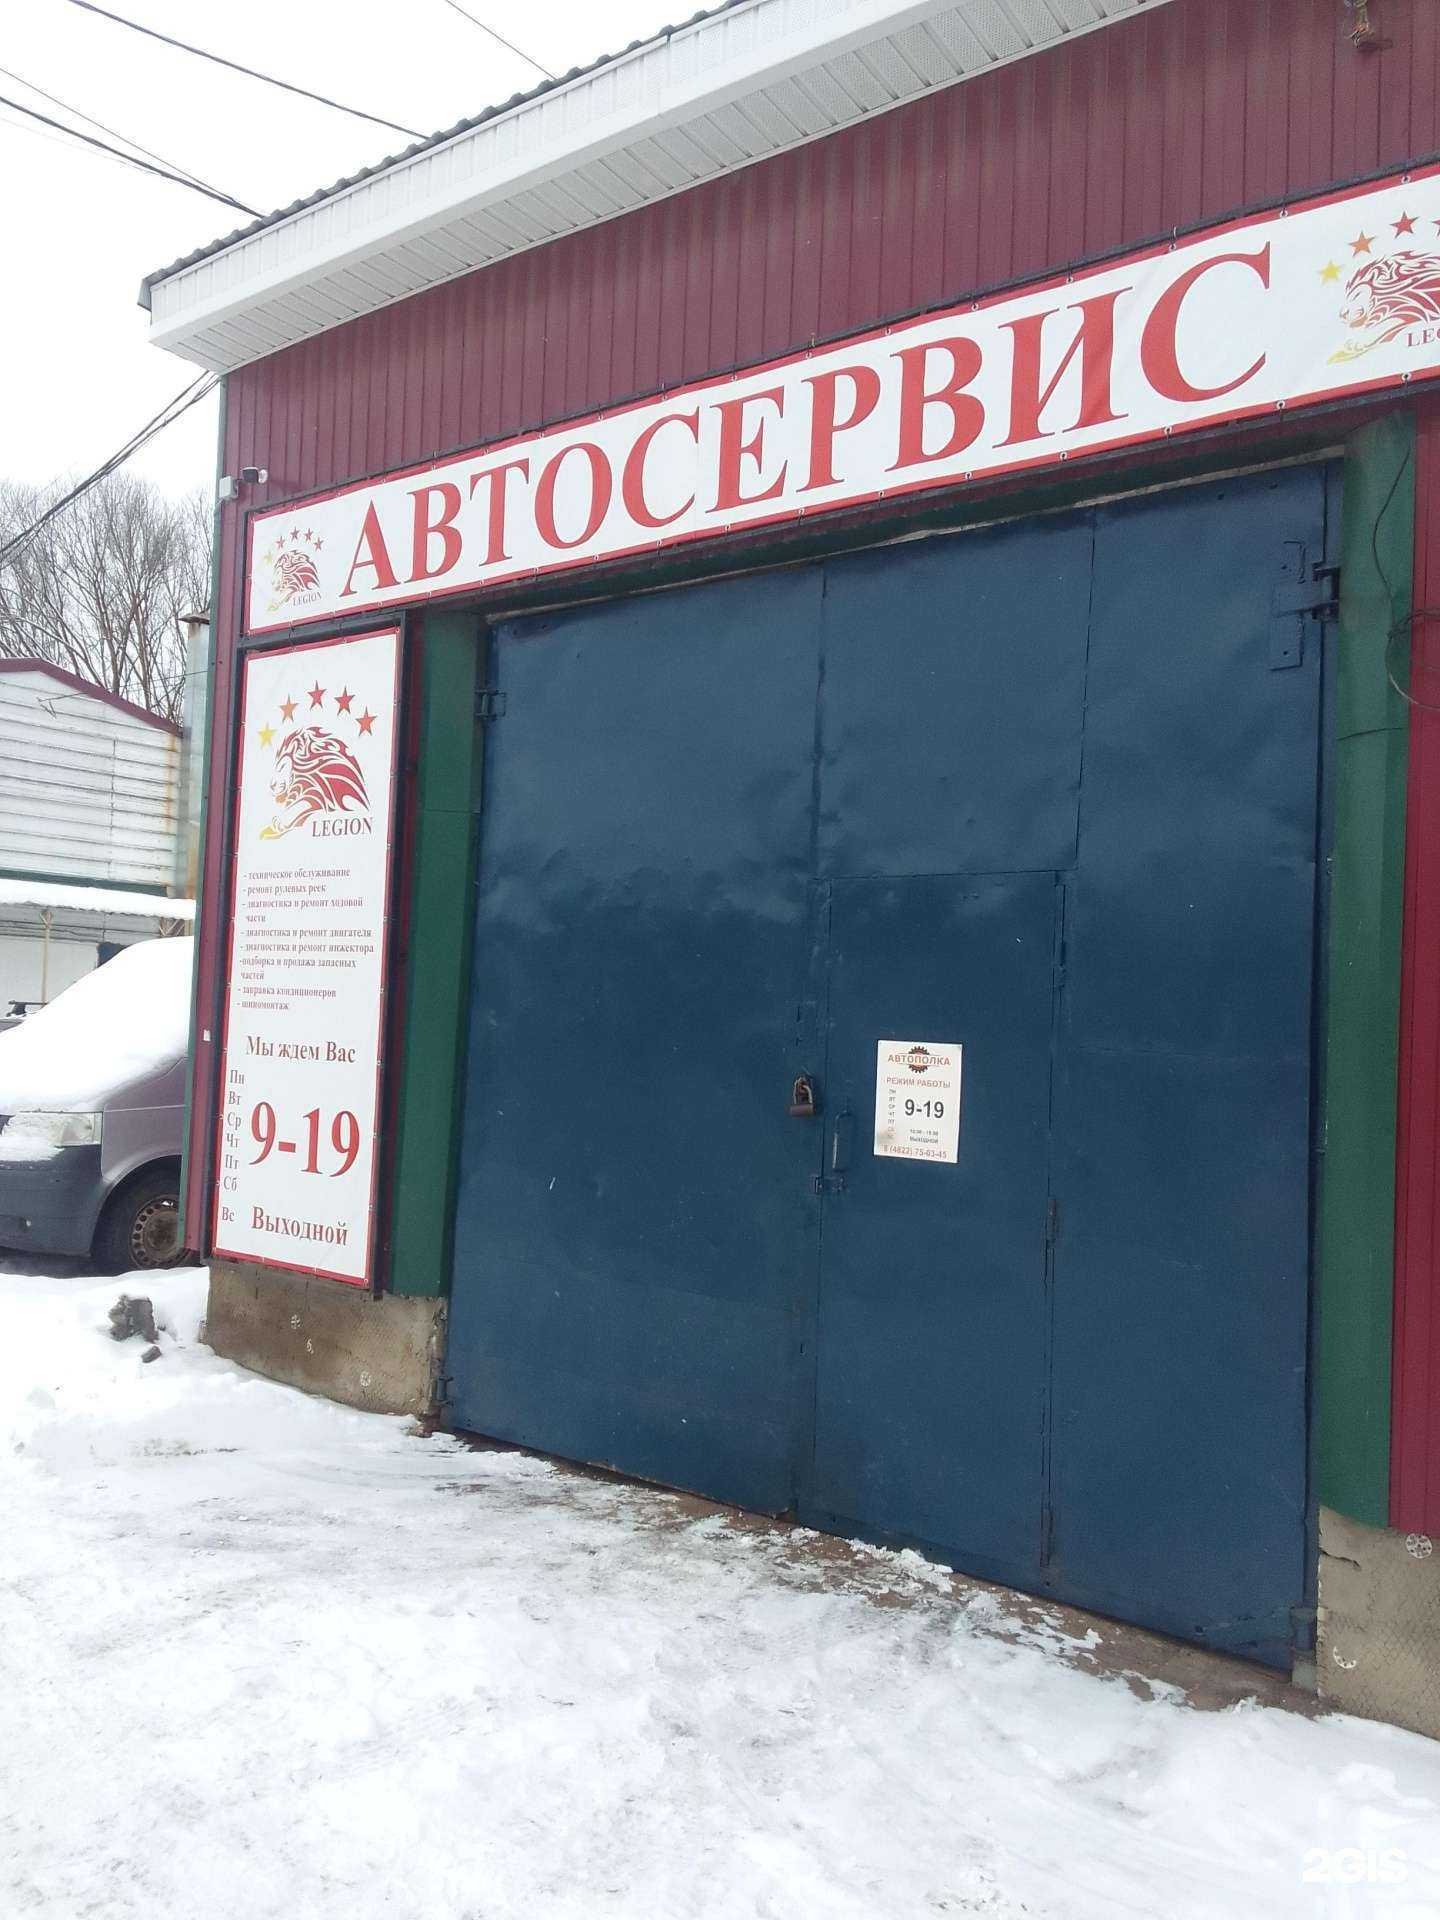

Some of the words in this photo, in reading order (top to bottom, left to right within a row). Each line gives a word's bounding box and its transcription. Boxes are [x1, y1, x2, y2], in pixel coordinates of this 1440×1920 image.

[1407, 327, 1440, 347] LE
[338, 242, 1271, 598] АВТОСЕРВИС
[293, 592, 322, 606] LEGION
[312, 817, 373, 837] LEGION
[248, 870, 292, 880] техническое
[294, 868, 351, 880] обслуживание
[247, 886, 273, 896] ремонт
[275, 884, 307, 896] рулевых
[308, 883, 327, 895] реек
[248, 899, 292, 909] диагностика
[301, 899, 329, 910] ремонт
[330, 896, 363, 908] ходовой
[246, 914, 266, 922] части
[246, 929, 291, 938] диагностика
[299, 929, 327, 940] ремонт
[328, 929, 372, 938] двигателя
[246, 943, 290, 952] диагностика
[298, 943, 327, 954] ремонт
[328, 944, 374, 956] инжектора
[283, 958, 316, 968] продажа
[317, 959, 357, 968] запасных
[241, 970, 265, 980] частей
[276, 987, 337, 999] кондиционеров
[241, 1000, 289, 1010] шиномонтаж
[246, 1035, 274, 1056] Мы
[278, 1043, 320, 1061] ждем
[326, 1041, 356, 1063] Вас
[888, 1054, 951, 1066] АВТОПОЛКА
[229, 1069, 245, 1085] Пн
[887, 1076, 915, 1087] РЕЖИМ
[917, 1078, 951, 1089] РАБОТЫ
[228, 1091, 242, 1106] Вт
[904, 1099, 944, 1119] 9-19
[227, 1112, 242, 1130] Ср
[226, 1133, 239, 1149] Чт
[249, 1101, 360, 1178] 9-19
[225, 1154, 239, 1170] Пт
[223, 1175, 238, 1192] Сб
[221, 1207, 235, 1222] Вс
[251, 1206, 348, 1246] Выходной
